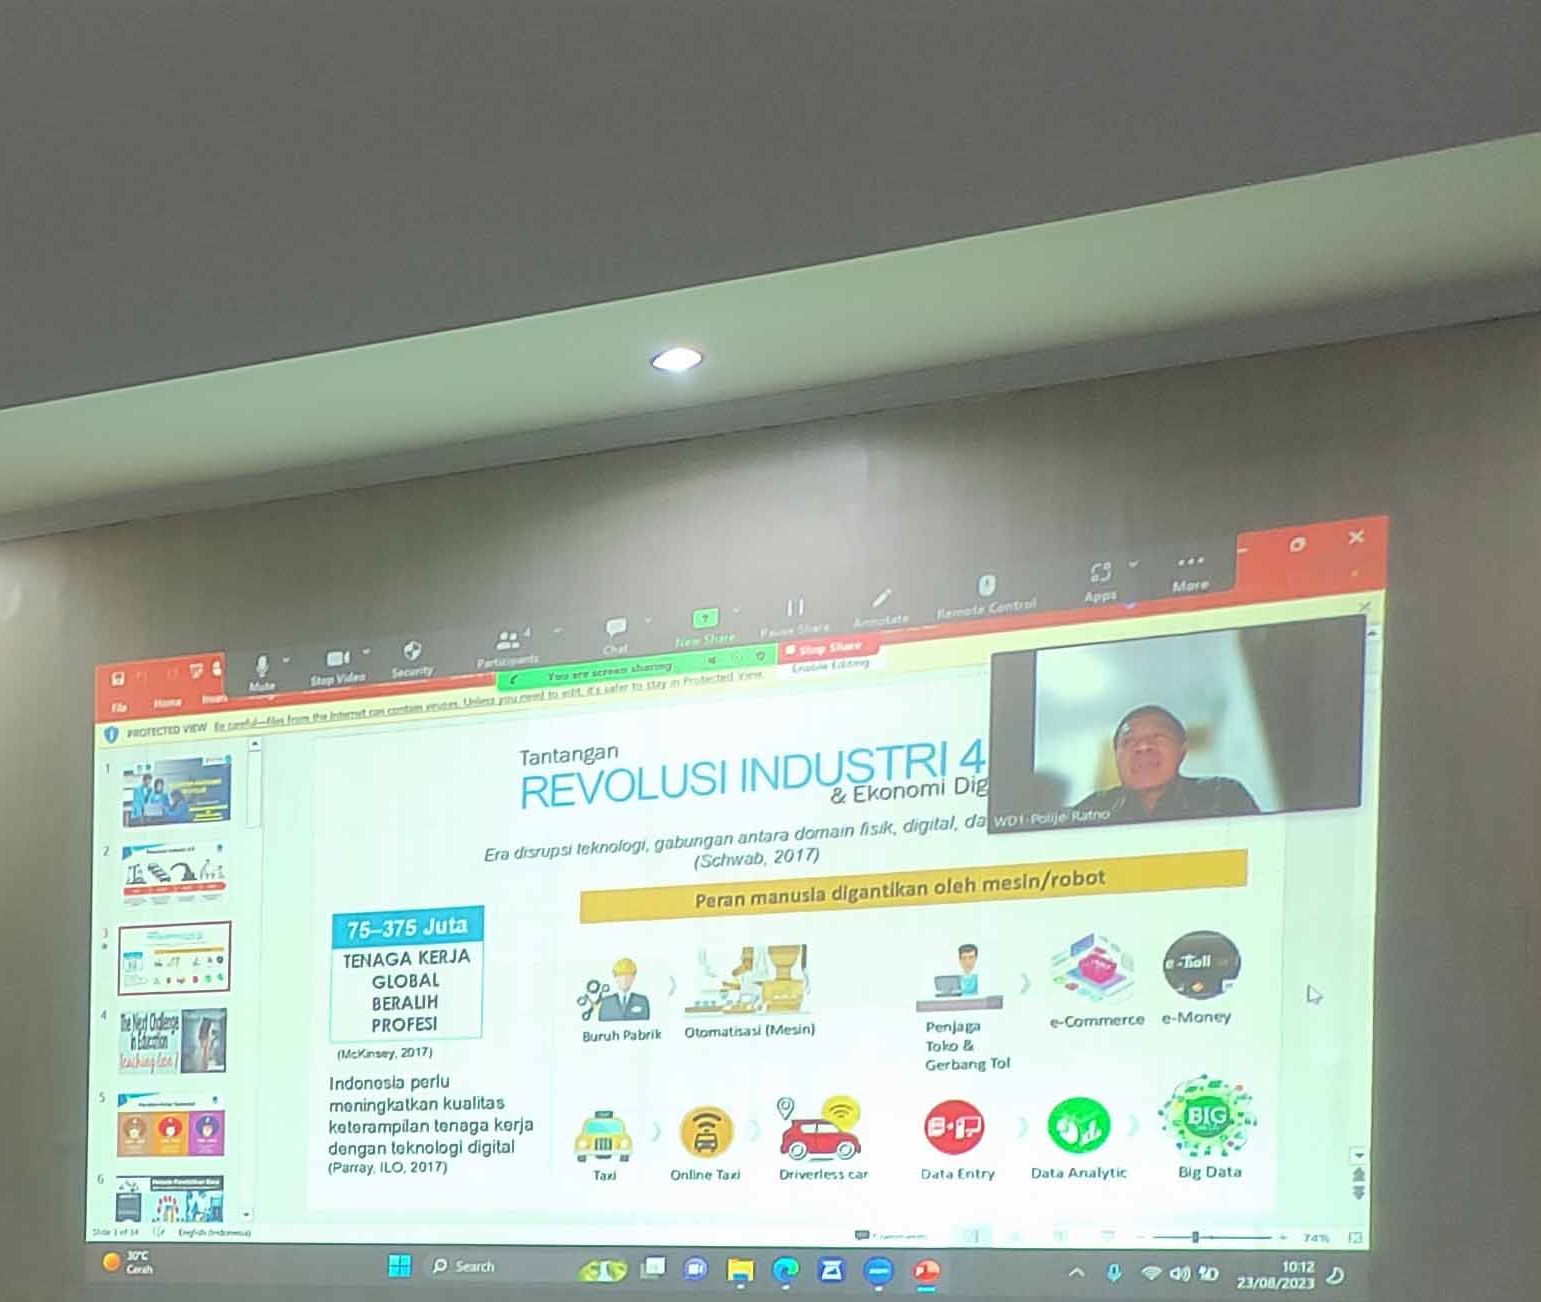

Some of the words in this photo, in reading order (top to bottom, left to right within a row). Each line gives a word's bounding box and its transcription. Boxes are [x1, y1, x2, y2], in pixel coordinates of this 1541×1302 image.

[1172, 580, 1210, 593] More
[1084, 591, 1117, 604] Apps
[603, 644, 629, 655] Chat
[391, 665, 434, 679] Security
[127, 725, 180, 738] PROTECTED
[183, 723, 207, 734] VIEW
[520, 745, 619, 767] Tantangan
[521, 759, 726, 810] REVOLUSI
[741, 740, 947, 793] INDUSTRI
[959, 738, 986, 774] 4
[830, 786, 846, 804] &
[853, 778, 945, 803] Ekonomi
[484, 847, 510, 863] Era
[514, 842, 572, 862] disrupsi
[576, 837, 650, 857] teknologi,
[654, 832, 733, 851] gabungan
[738, 829, 789, 845] antara
[794, 825, 854, 842] domain
[859, 820, 897, 837] fisik,
[903, 814, 959, 836] digital,
[693, 850, 767, 872] (Schwab,
[774, 846, 820, 866] 2017)
[695, 892, 745, 909] Peran
[750, 887, 826, 906] manusia
[831, 881, 928, 903] digantikan
[934, 877, 976, 894] oleh
[982, 868, 1106, 892] mesin/robot
[423, 916, 468, 936] Juta
[343, 951, 412, 969] TENAGA
[418, 948, 471, 965] KERJA
[372, 972, 440, 989] GLOBAL
[372, 994, 438, 1011] BERALIH
[372, 1016, 437, 1033] PROFESI
[1049, 1014, 1146, 1029] e-Commerce
[1162, 1011, 1232, 1027] e-Money
[583, 1030, 620, 1043] Buruh
[623, 1028, 662, 1041] Pabrik
[684, 1025, 762, 1039] Otomatisasi
[765, 1023, 816, 1037] (Mesin)
[926, 1020, 981, 1035] Penjaga
[337, 1047, 398, 1061] (McKinsey,
[401, 1046, 433, 1059] 2017)
[926, 1040, 959, 1052] Toko
[963, 1039, 974, 1052] &
[925, 1058, 987, 1072] Gerbang
[990, 1056, 1011, 1069] Tol
[329, 1074, 405, 1091] Indonesia
[410, 1073, 450, 1093] perlu
[329, 1096, 439, 1116] meningkatkan
[442, 1095, 505, 1111] kualitas
[1187, 1106, 1227, 1126] BIG
[328, 1118, 430, 1136] keterampilan
[434, 1120, 489, 1136] tenaga
[493, 1116, 534, 1135] kerja
[328, 1141, 387, 1159] dengan
[391, 1139, 463, 1159] teknologi
[467, 1139, 515, 1159] digital
[328, 1161, 376, 1176] (Parray,
[380, 1161, 407, 1175] ILO,
[410, 1161, 448, 1175] 2017)
[594, 1170, 617, 1181] Taxi
[670, 1169, 713, 1181] Online
[716, 1169, 741, 1181] Taxi
[779, 1168, 845, 1181] Driverless
[847, 1170, 868, 1180] car
[921, 1168, 954, 1180] Data
[958, 1168, 995, 1182] Entry
[1031, 1167, 1064, 1180] Data
[1068, 1166, 1128, 1182] Analytic
[1178, 1166, 1202, 1182] Big
[1206, 1166, 1242, 1179] Data
[456, 1259, 495, 1275] Search
[1282, 1260, 1316, 1273] 10:12
[1236, 1277, 1316, 1290] 23/08/2023
